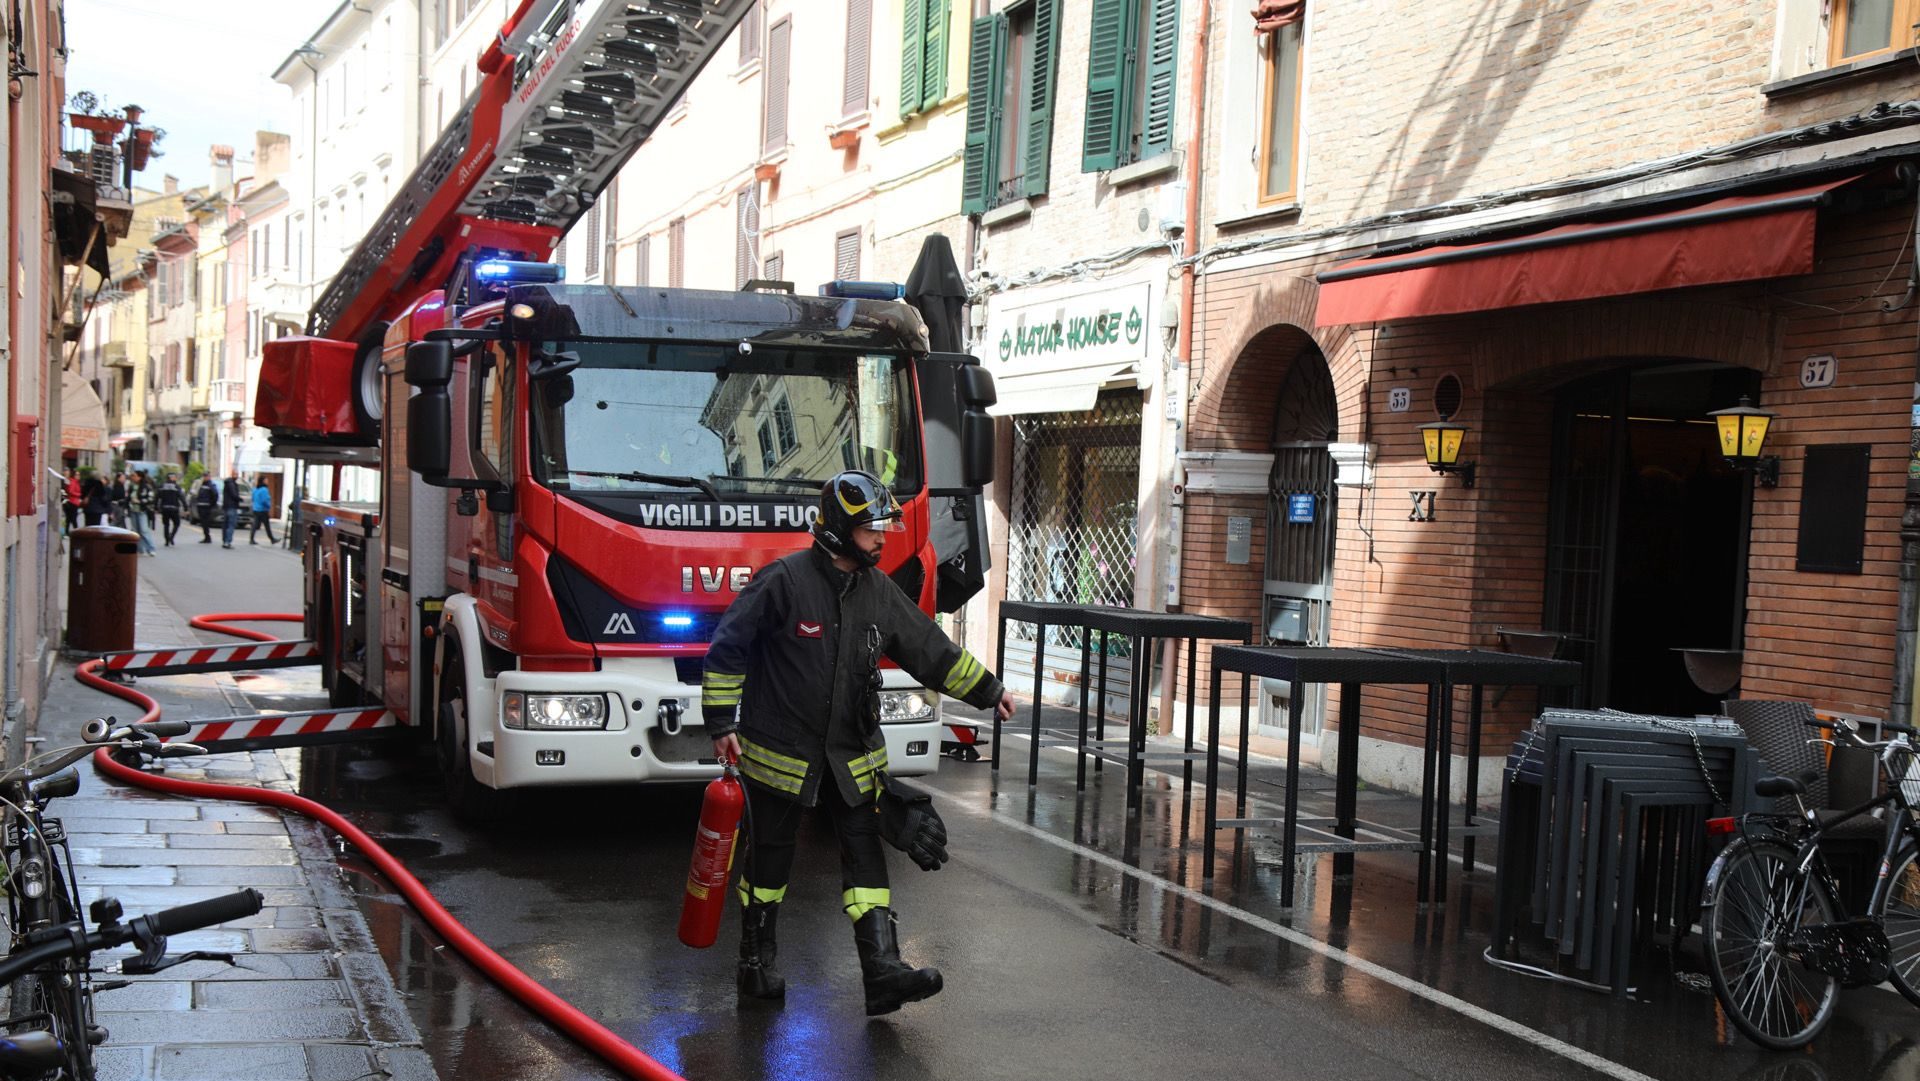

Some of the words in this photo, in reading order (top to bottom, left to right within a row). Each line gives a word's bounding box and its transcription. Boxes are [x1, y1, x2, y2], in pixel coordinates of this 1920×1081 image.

[519, 73, 541, 104] VIGILI
[540, 57, 556, 80] DEL
[555, 20, 582, 58] FUOCO
[1014, 320, 1065, 357] NATUR
[1066, 312, 1123, 351] HOUSE
[1805, 360, 1830, 383] 57
[1392, 392, 1408, 409] 55
[640, 504, 711, 527] VIGILI
[719, 504, 767, 527] DEL
[774, 504, 820, 527] FUO
[1408, 491, 1438, 522] XI
[681, 566, 753, 593] IVE
